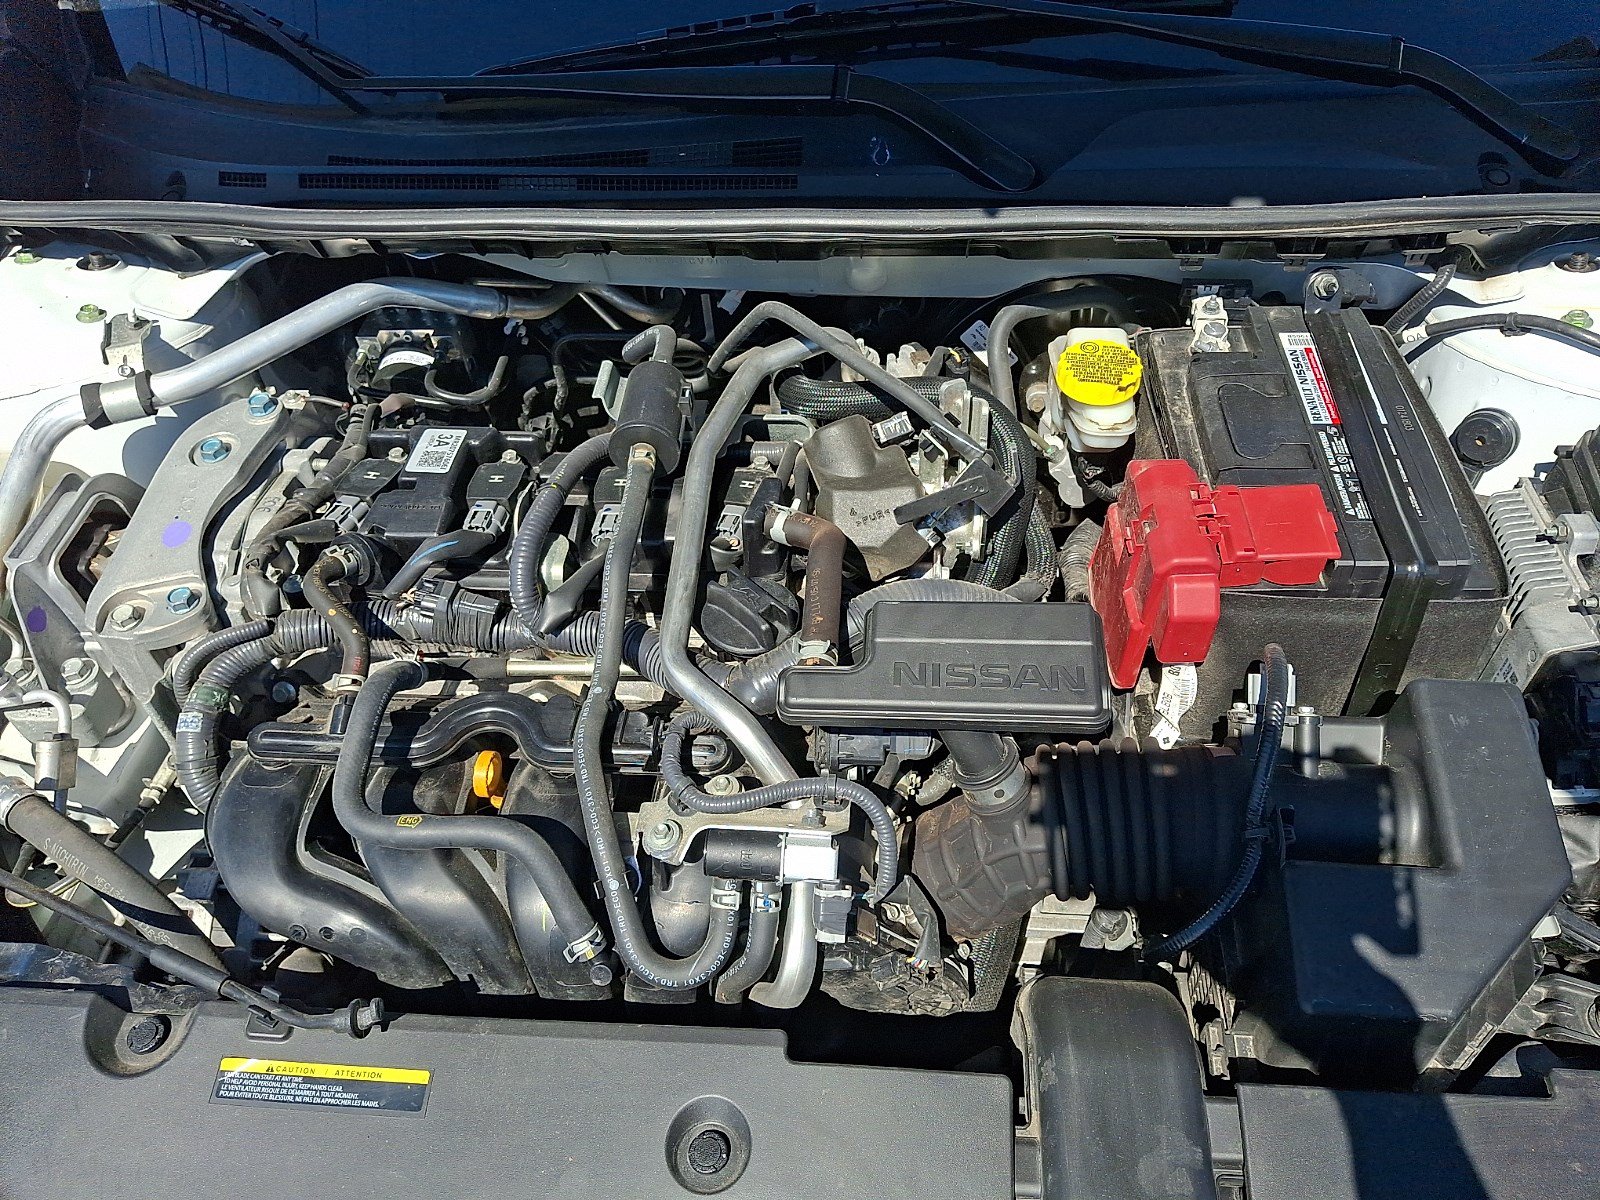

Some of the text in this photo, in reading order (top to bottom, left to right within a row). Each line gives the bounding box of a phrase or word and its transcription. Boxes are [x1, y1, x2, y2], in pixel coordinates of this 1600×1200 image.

[1288, 349, 1310, 385] NISSAN
[1302, 386, 1323, 422] RENAULT
[432, 433, 454, 448] 3A
[892, 661, 1087, 692] NISSAN
[276, 1065, 316, 1075] CAUTION
[334, 1069, 383, 1079] ATTENTION
[228, 1084, 260, 1092] VENTILATEUR
[321, 1098, 352, 1106] APPROCHER
